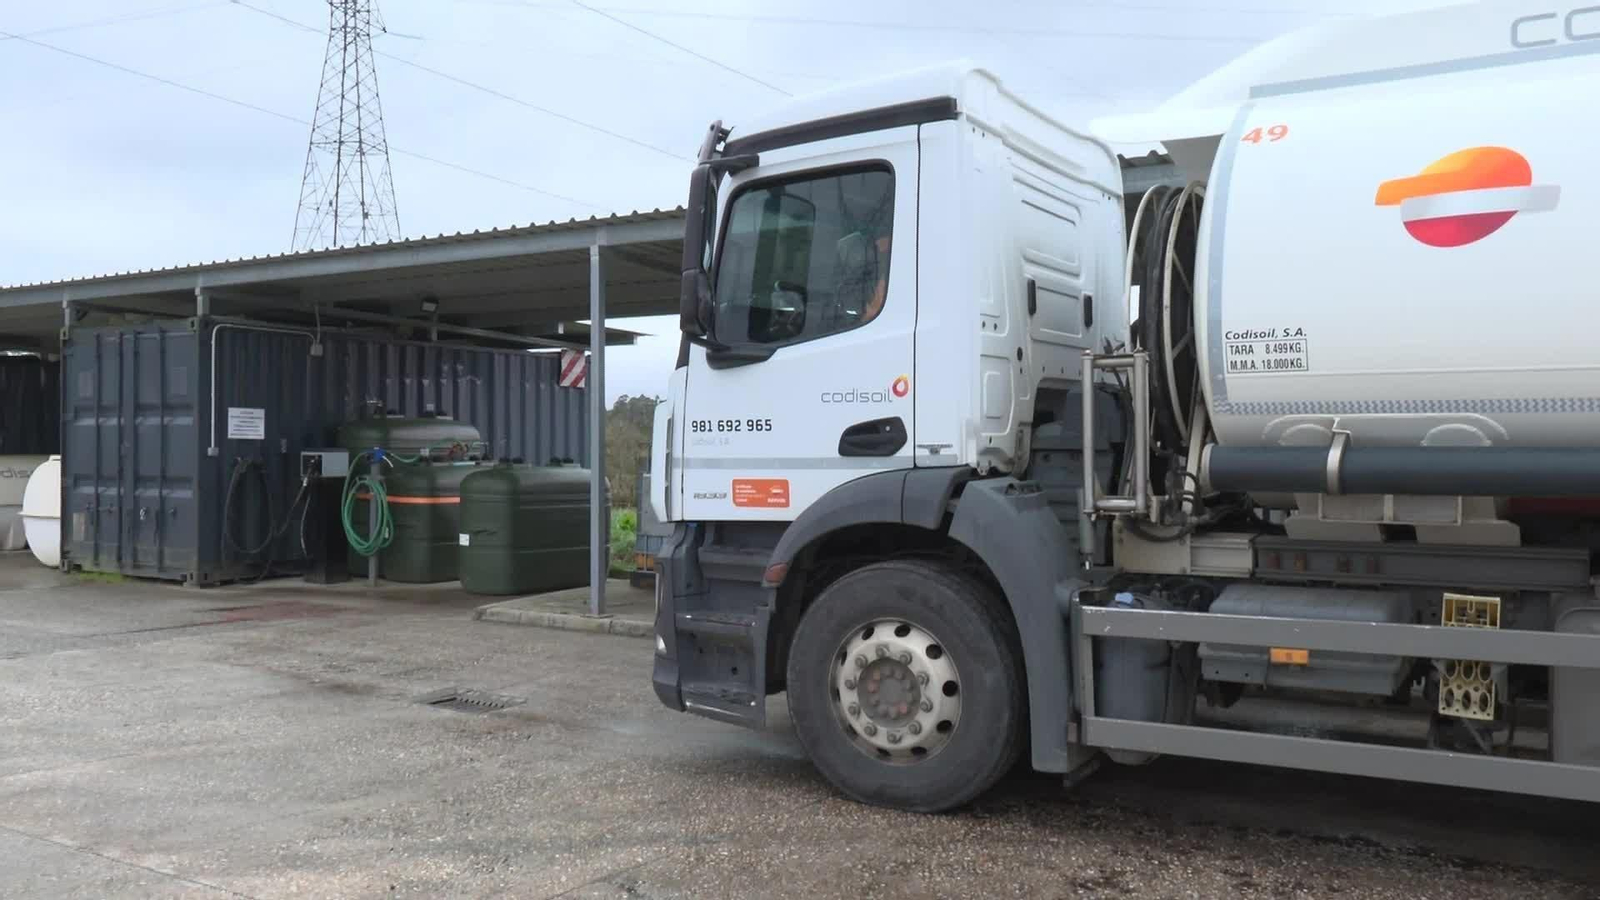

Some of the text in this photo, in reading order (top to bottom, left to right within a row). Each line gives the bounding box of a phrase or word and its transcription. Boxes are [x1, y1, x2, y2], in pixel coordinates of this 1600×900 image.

[1240, 125, 1288, 144] 49
[1225, 327, 1307, 340] Codisoil, S.A.
[1229, 344, 1254, 355] TARA
[1230, 360, 1258, 370] M.M.A.
[821, 388, 893, 403] codisoil
[691, 419, 772, 432] 981 692 965
